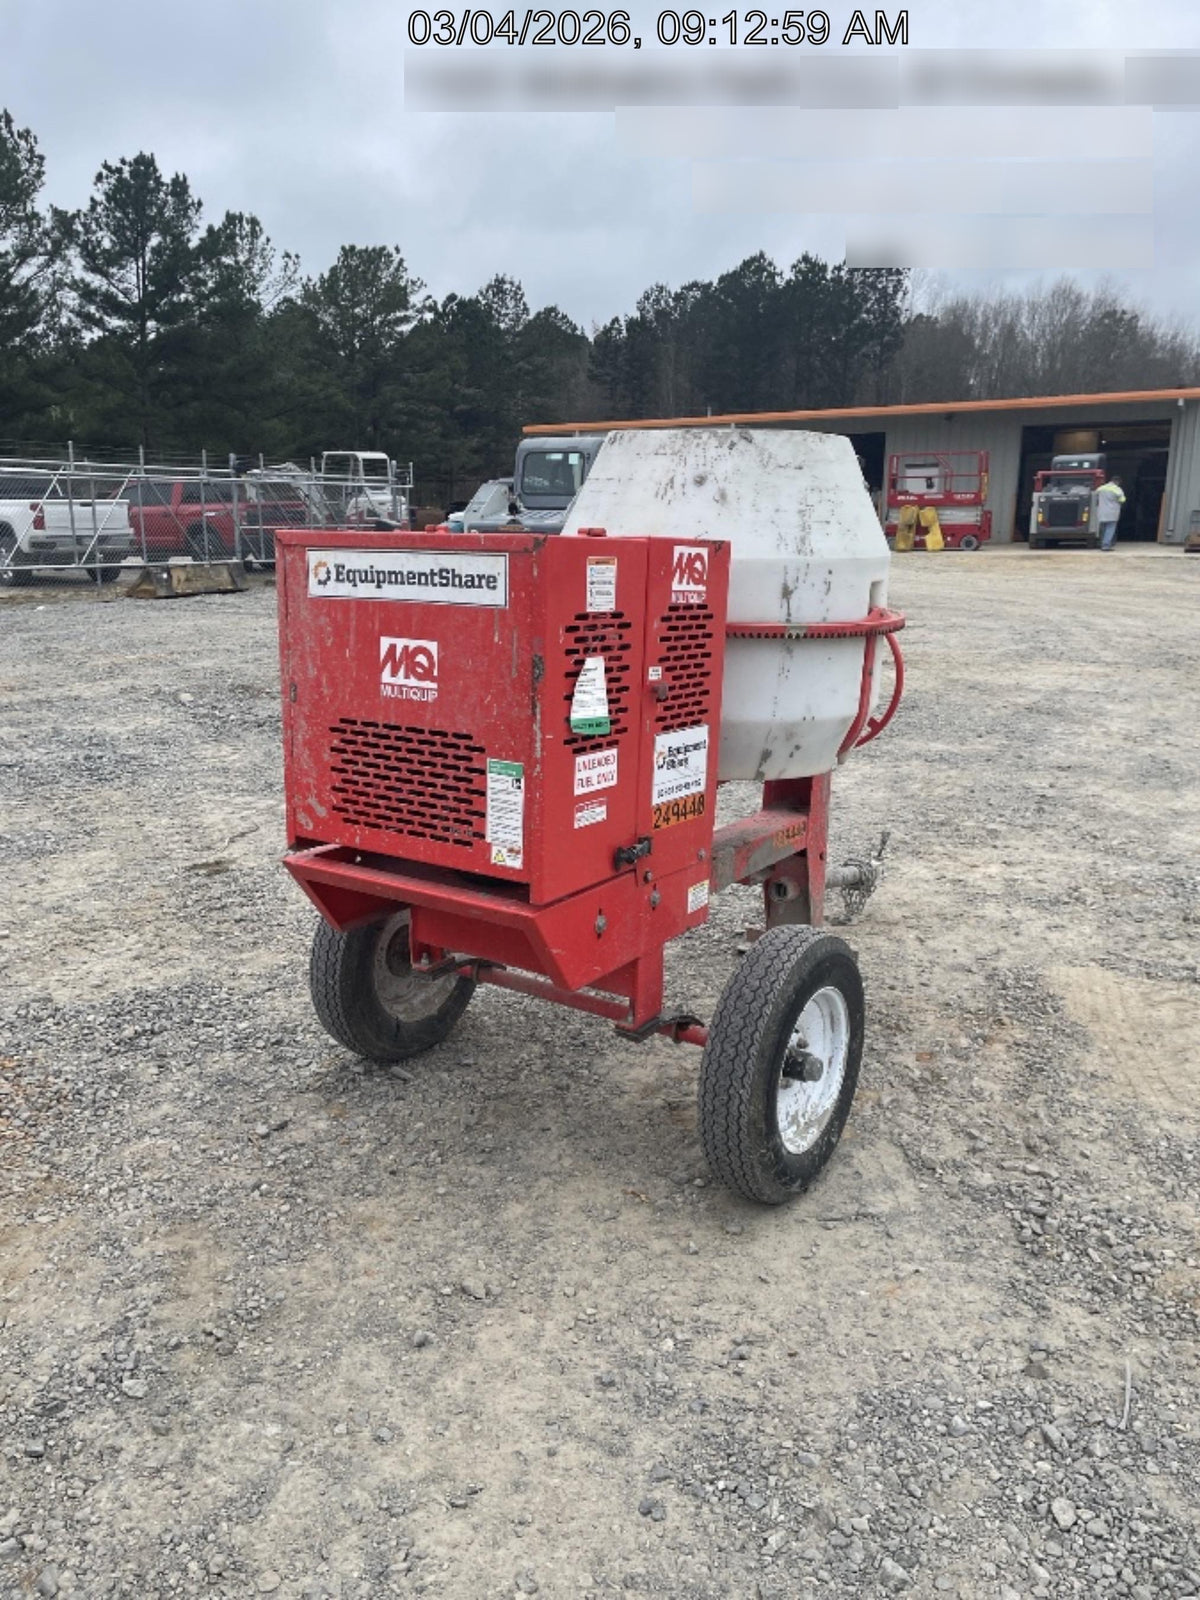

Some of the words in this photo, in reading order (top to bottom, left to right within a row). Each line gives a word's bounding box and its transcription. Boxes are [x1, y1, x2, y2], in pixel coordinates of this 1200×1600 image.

[333, 563, 498, 591] EquipmentShare
[672, 552, 707, 586] MQ
[380, 642, 437, 682] MQ
[380, 684, 438, 702] MULTIQUIP
